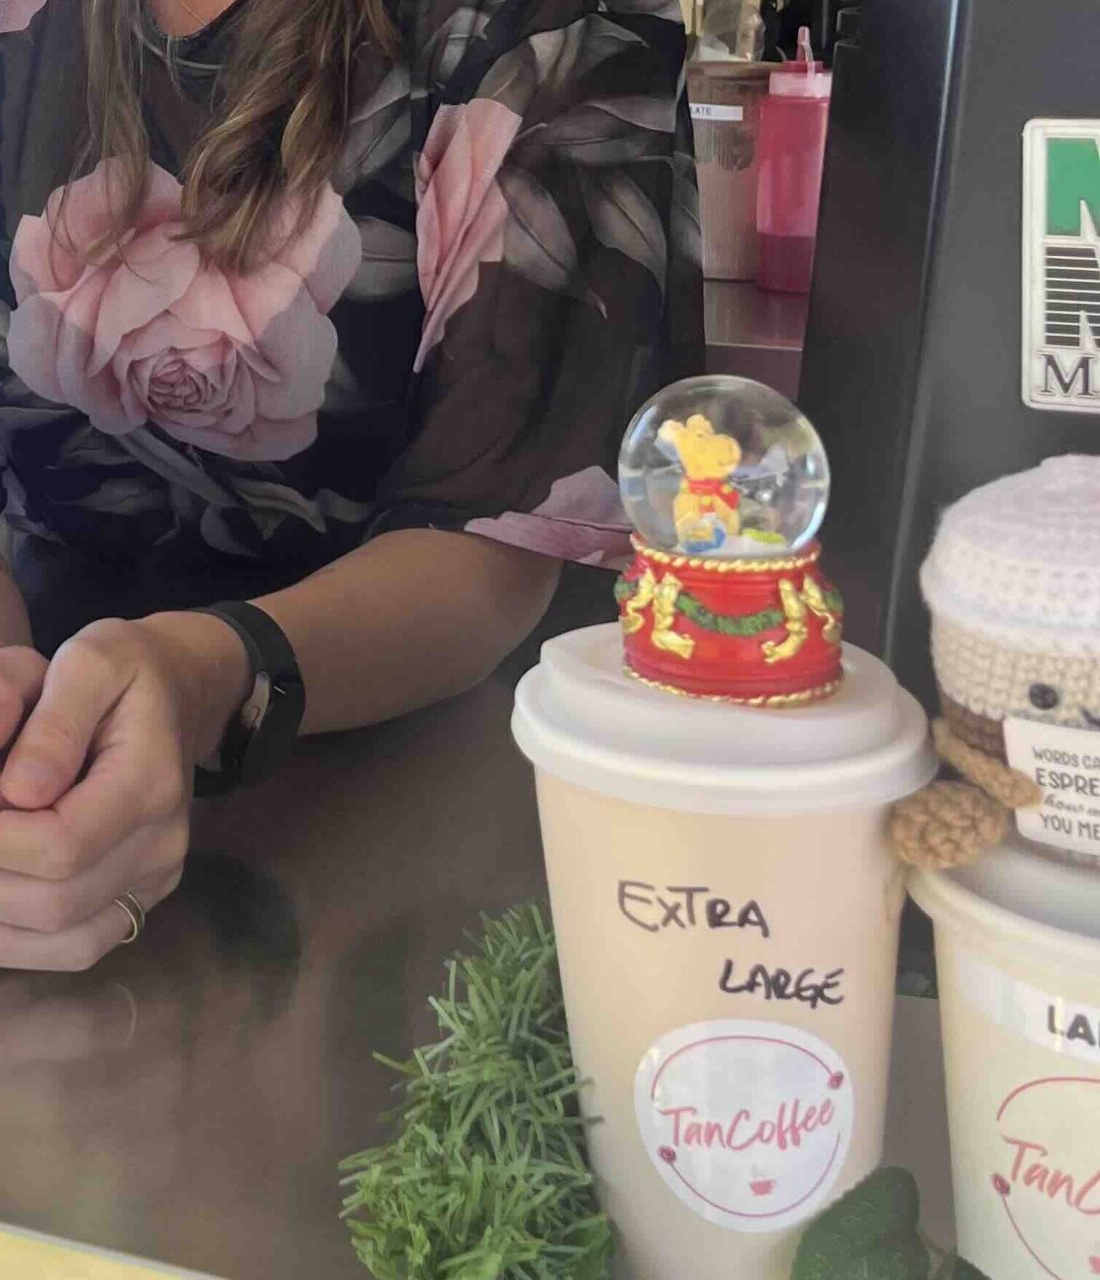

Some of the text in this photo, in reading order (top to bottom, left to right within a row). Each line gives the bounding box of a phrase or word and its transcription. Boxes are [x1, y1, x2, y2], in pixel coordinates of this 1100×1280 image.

[1031, 745, 1079, 767] WORDS
[1035, 767, 1100, 797] ESPRE
[1038, 811, 1073, 834] YOU
[719, 959, 844, 1009] LARGE
[1047, 1004, 1100, 1047] LA
[655, 1098, 835, 1151] TanCoffee
